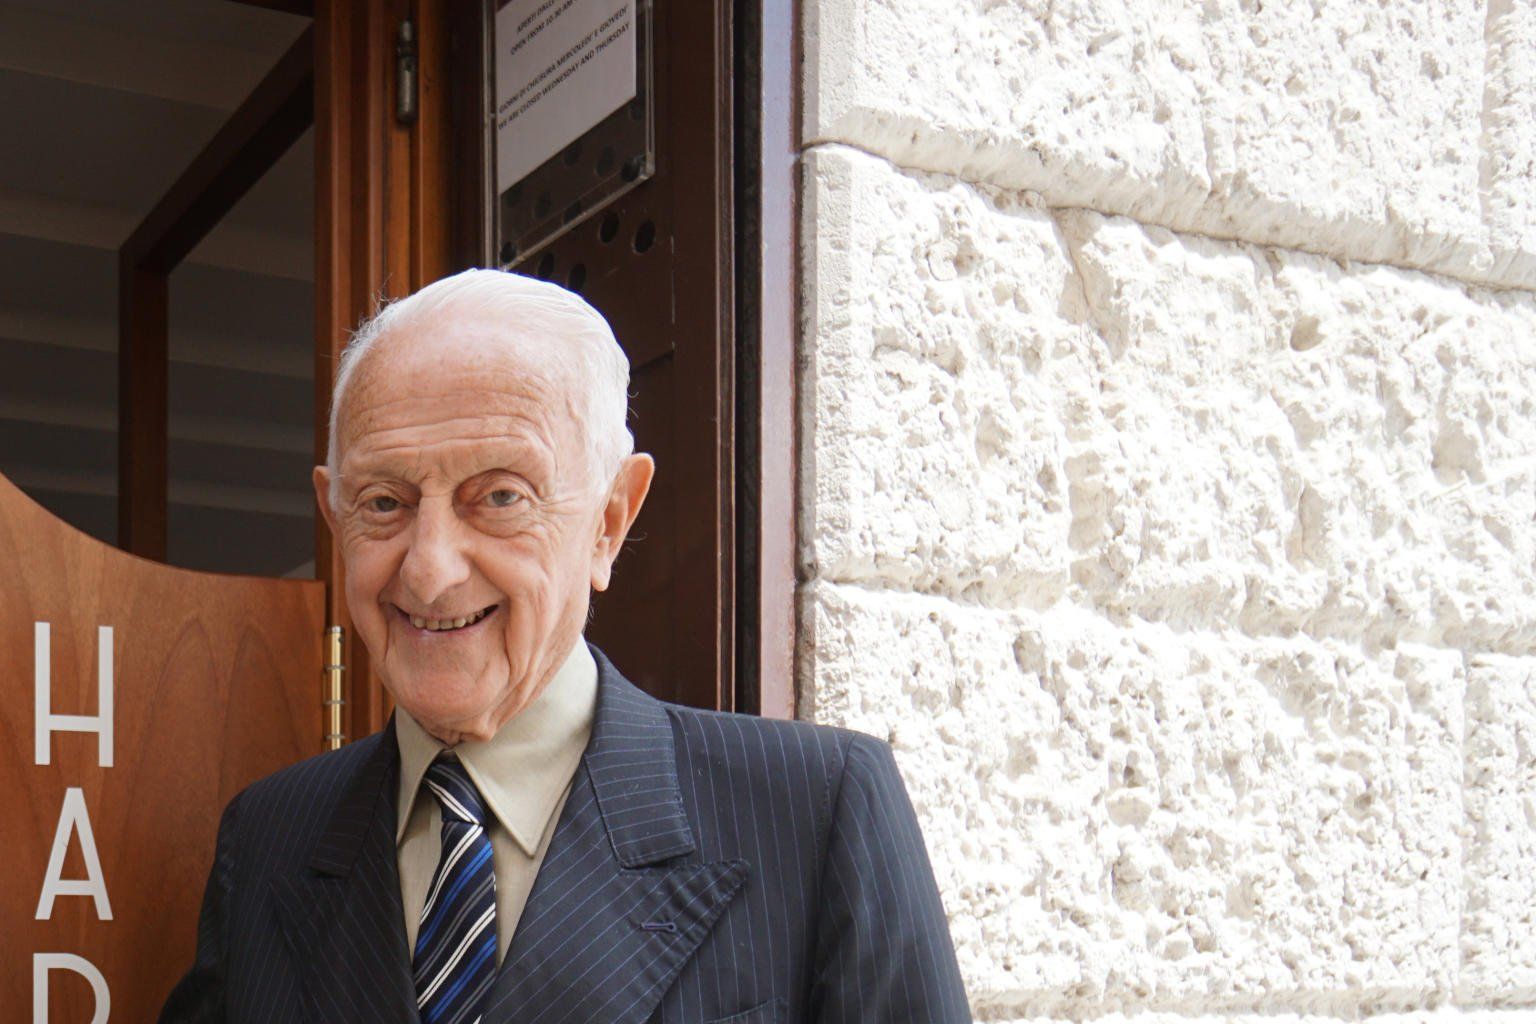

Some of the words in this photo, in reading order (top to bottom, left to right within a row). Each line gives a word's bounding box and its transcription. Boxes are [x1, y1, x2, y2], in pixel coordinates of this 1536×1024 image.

[520, 91, 541, 113] CLOSED
[542, 61, 580, 96] WEDNESDAY
[580, 49, 594, 66] AND
[595, 22, 629, 53] THURSDAY
